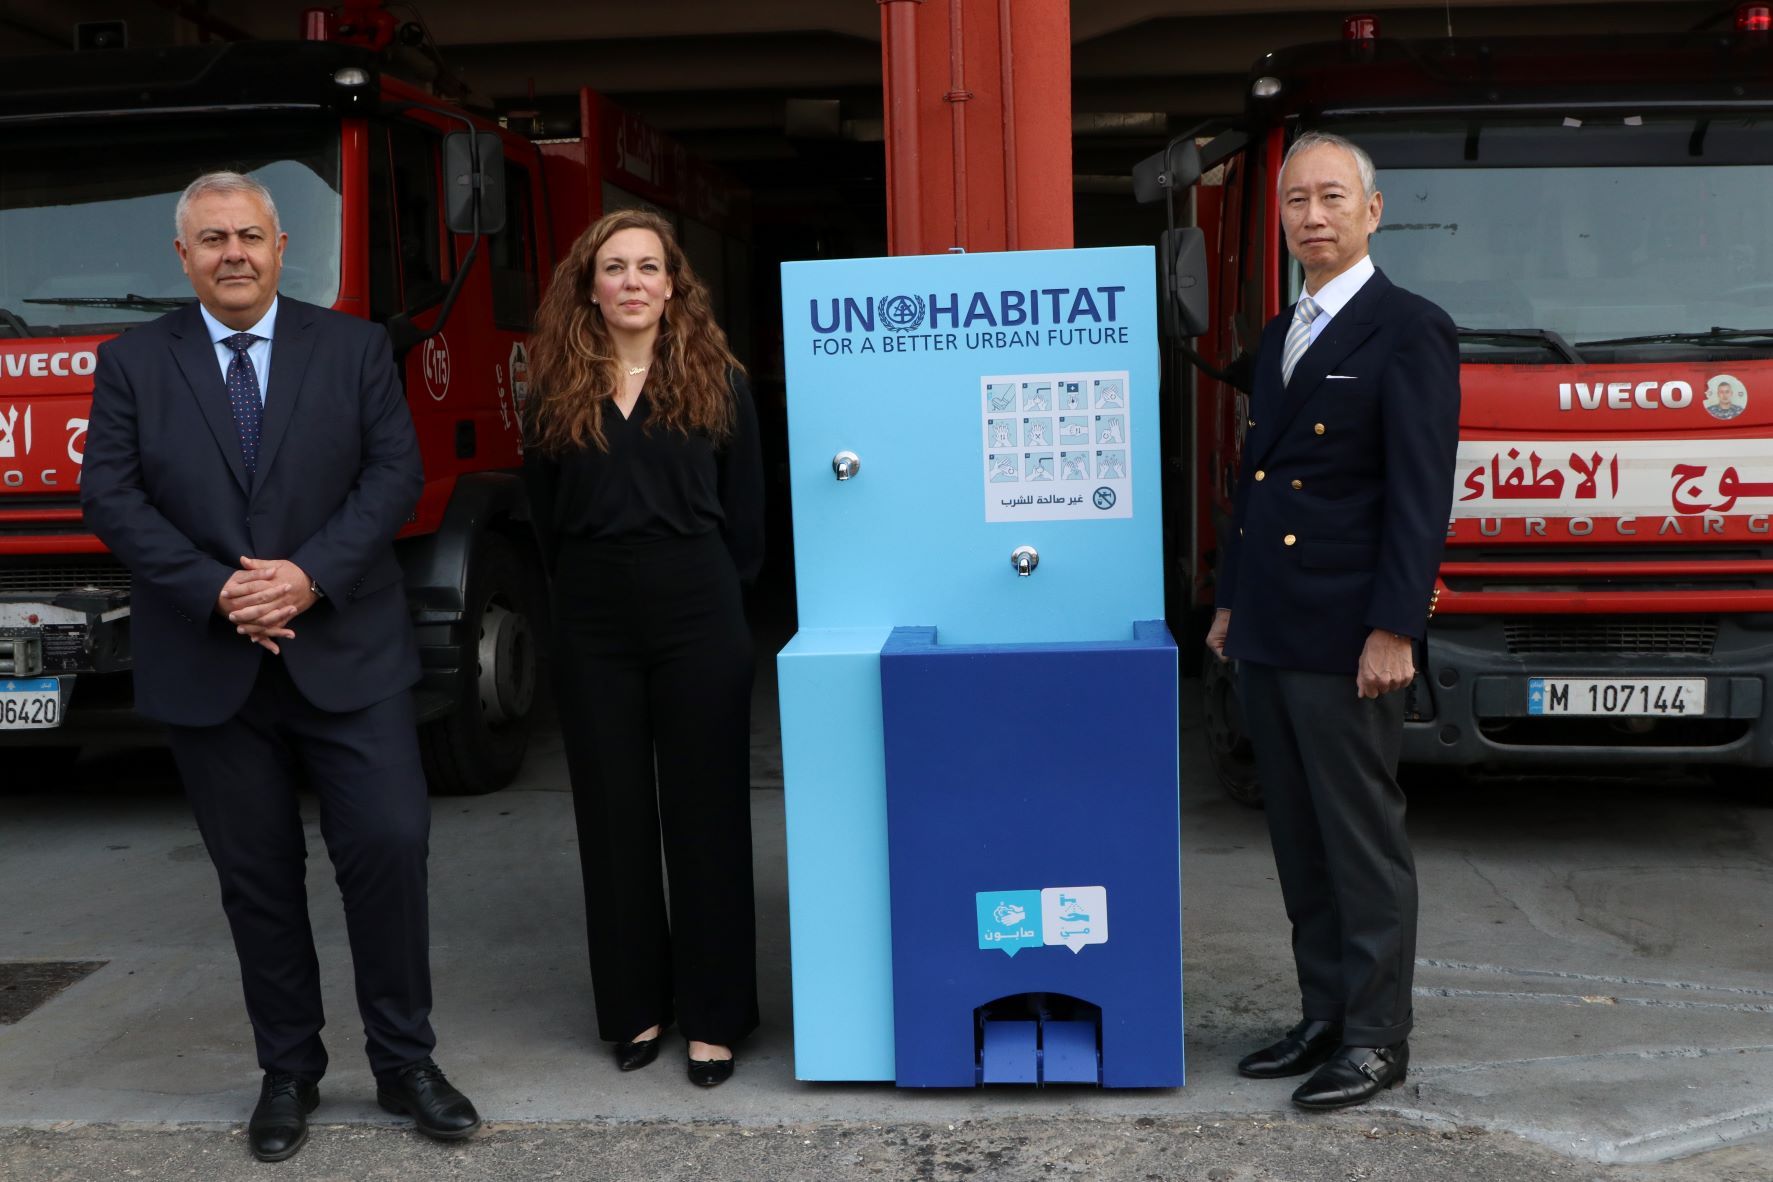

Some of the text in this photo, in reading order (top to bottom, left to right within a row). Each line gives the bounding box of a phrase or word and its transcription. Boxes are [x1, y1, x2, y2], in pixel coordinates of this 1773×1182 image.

[810, 286, 1126, 334] UN HABITAT
[812, 326, 1129, 356] FOR A BETTER URBAN FUTURE
[0, 351, 97, 377] VECO
[432, 349, 447, 385] 175
[1559, 381, 1693, 411] IVECO
[1458, 447, 1773, 515] وج الاطفاء
[1001, 494, 1084, 508] غير صالحة للشرب
[1550, 683, 1686, 713] M 107144
[984, 927, 1035, 941] صابون
